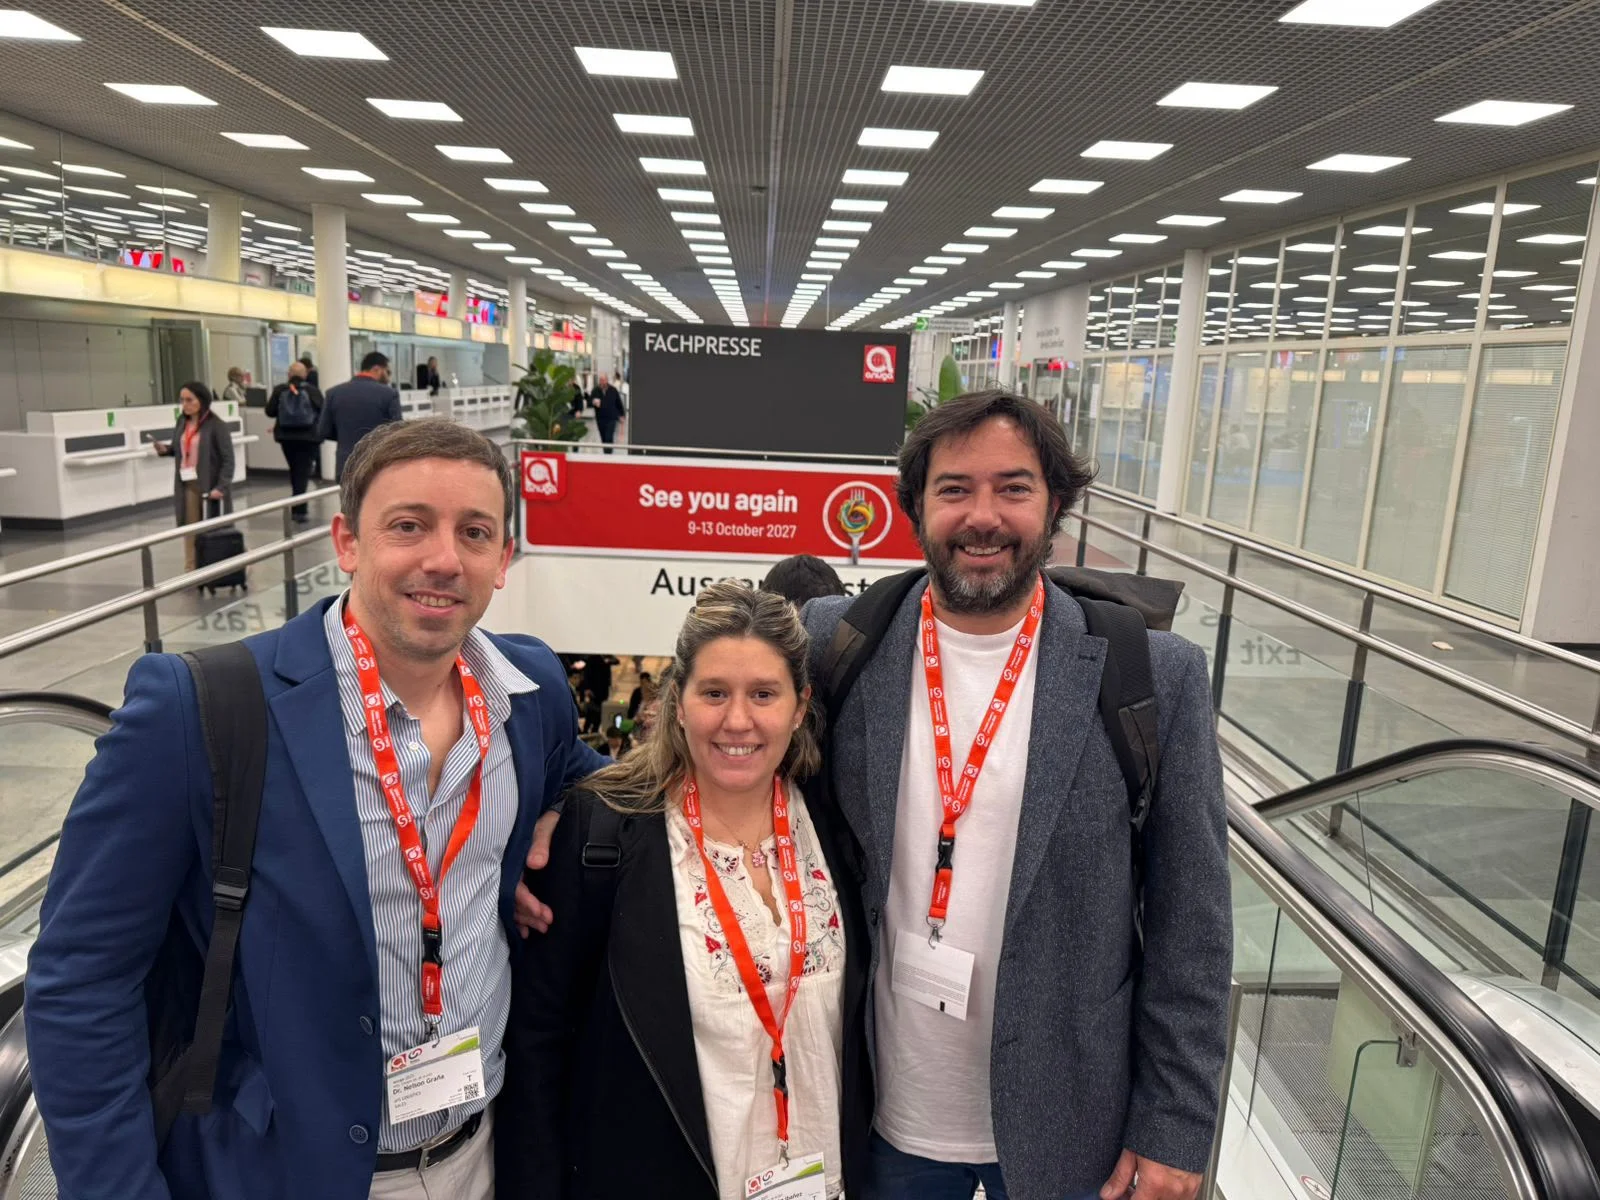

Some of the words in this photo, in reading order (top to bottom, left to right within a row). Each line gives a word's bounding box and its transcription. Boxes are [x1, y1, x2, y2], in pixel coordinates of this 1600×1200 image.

[645, 333, 762, 357] FACHPRESSE
[639, 483, 683, 508] See
[688, 491, 730, 514] you
[734, 489, 798, 517] again
[688, 521, 713, 535] 9-13
[716, 522, 764, 537] October
[766, 524, 797, 538] 2027
[403, 1080, 425, 1091] Nelson
